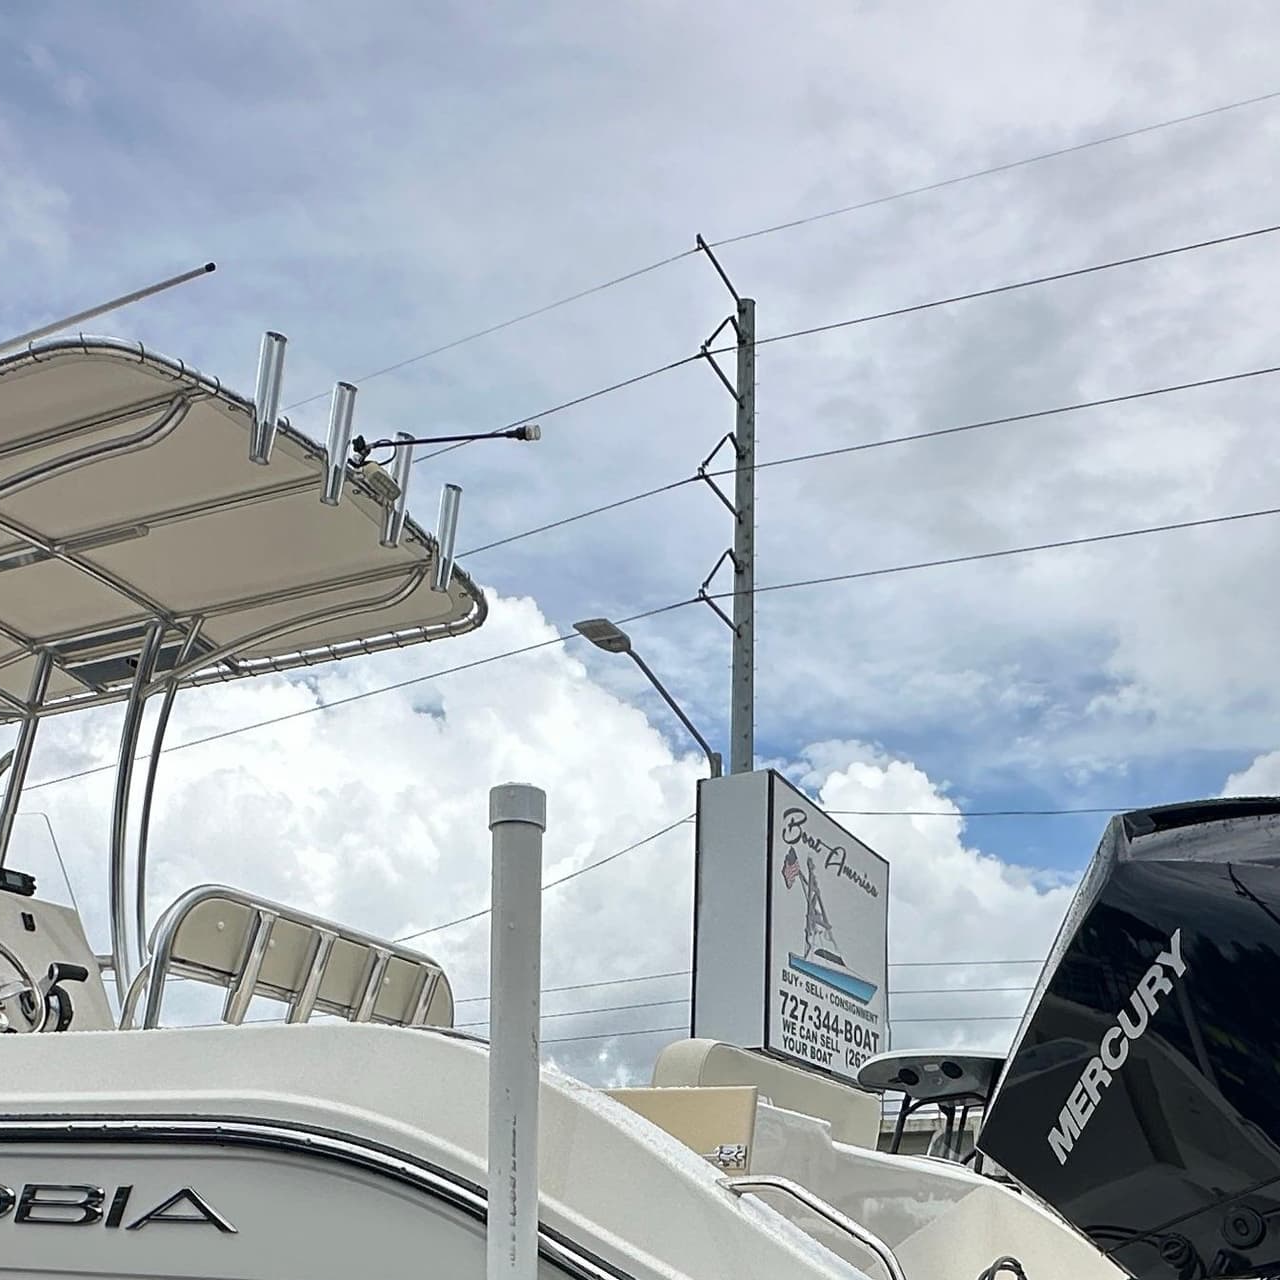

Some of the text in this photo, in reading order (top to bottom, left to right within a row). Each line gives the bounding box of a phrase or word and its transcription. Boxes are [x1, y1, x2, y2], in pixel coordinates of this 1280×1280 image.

[782, 807, 879, 898] Boat America
[779, 989, 880, 1054] 727-344-BOAT
[782, 968, 878, 1025] BUY SELL CONSIGNMENT
[782, 1017, 841, 1054] WE CAN SELL
[782, 1034, 833, 1065] YOUR BOAT
[1047, 927, 1187, 1166] MERCURY
